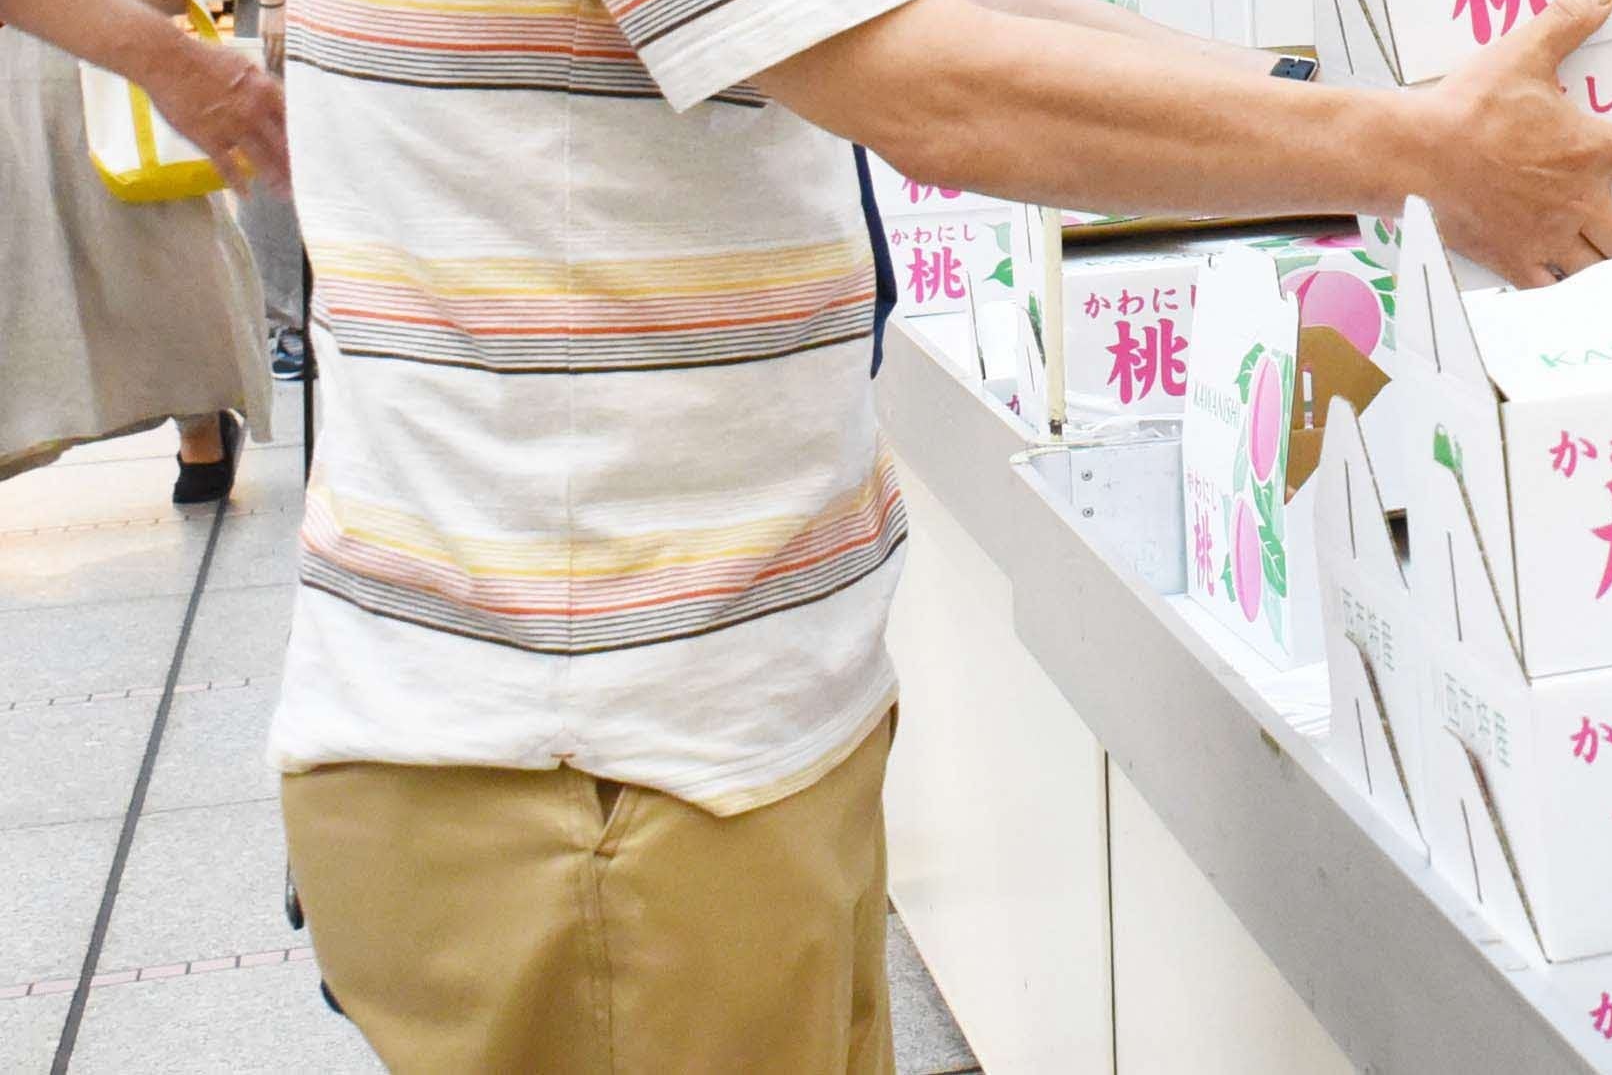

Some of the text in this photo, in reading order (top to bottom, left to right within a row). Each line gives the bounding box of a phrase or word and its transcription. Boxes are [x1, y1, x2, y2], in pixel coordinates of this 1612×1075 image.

[890, 224, 977, 246] かわにし
[906, 246, 966, 304] 桃
[1105, 318, 1189, 404] 桃
